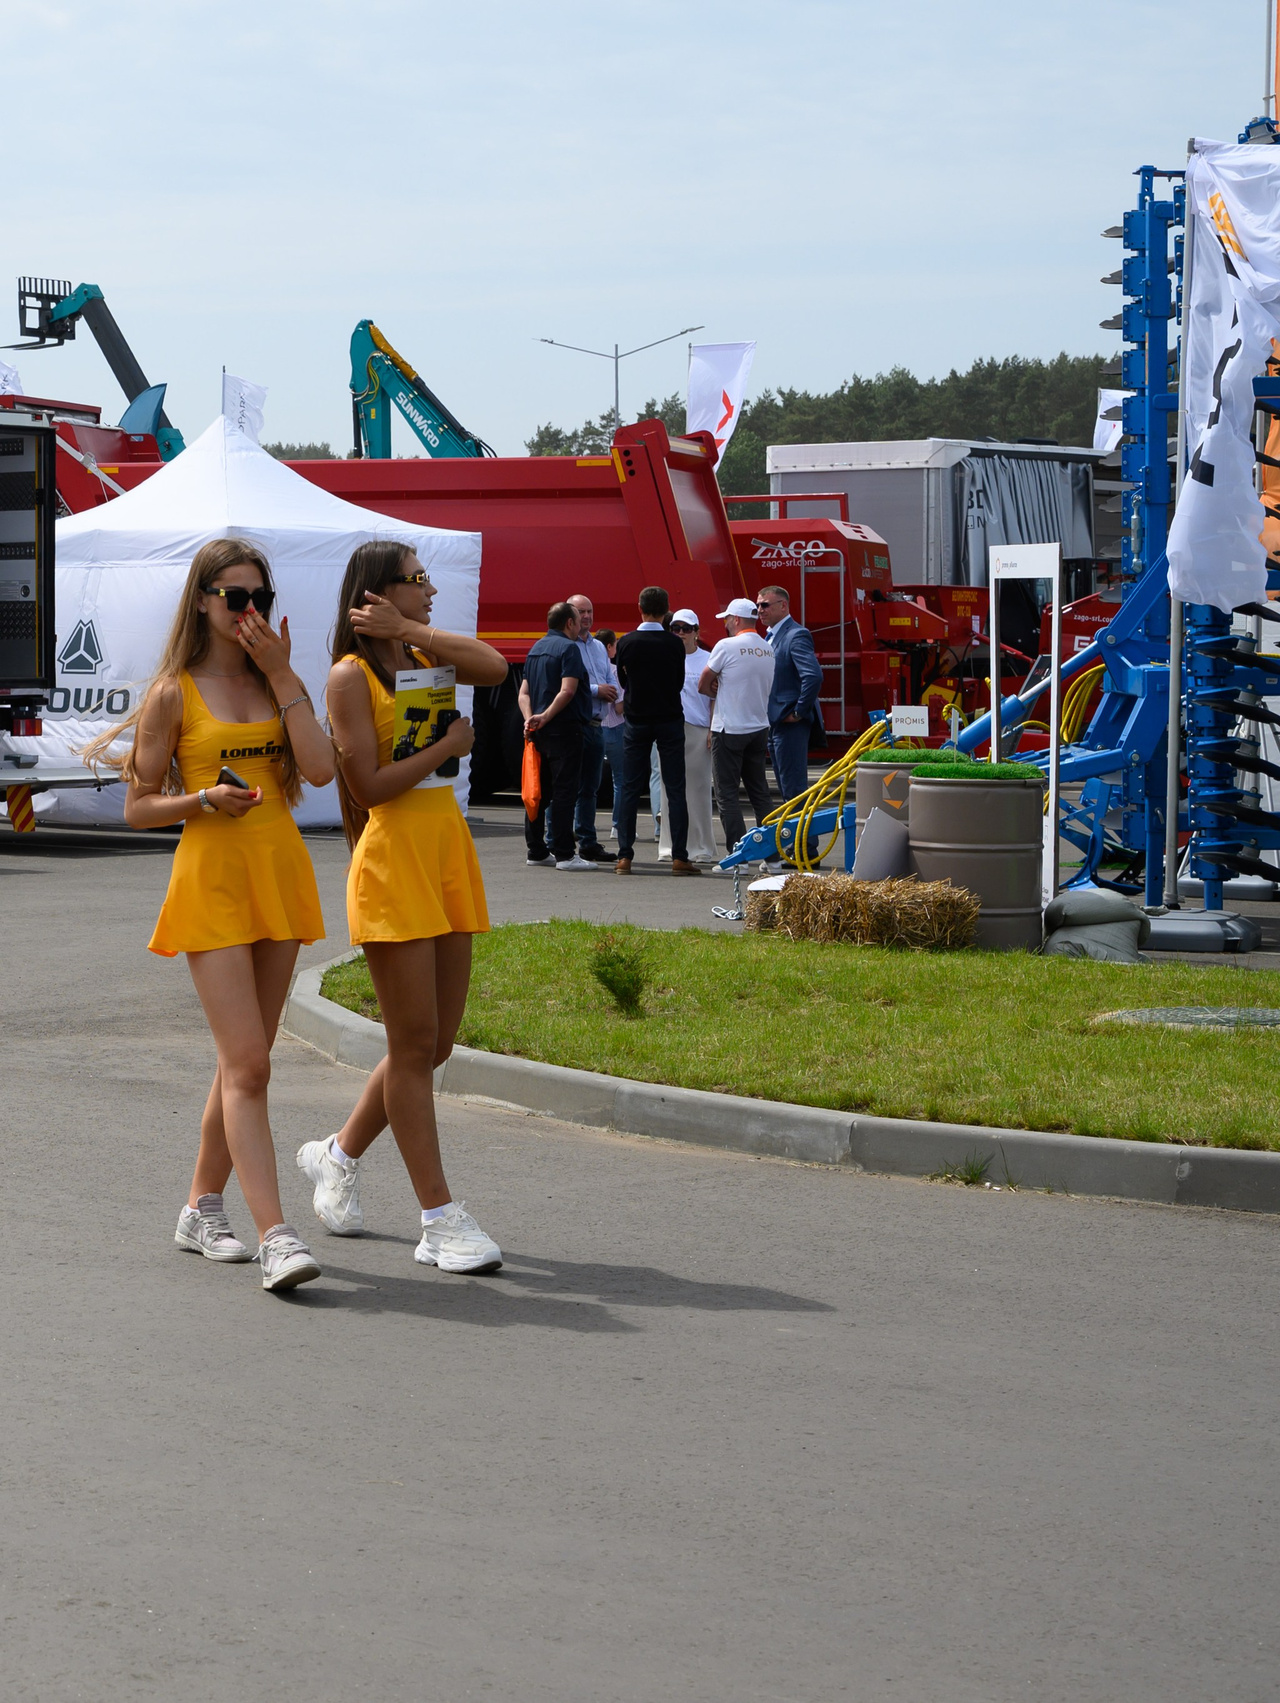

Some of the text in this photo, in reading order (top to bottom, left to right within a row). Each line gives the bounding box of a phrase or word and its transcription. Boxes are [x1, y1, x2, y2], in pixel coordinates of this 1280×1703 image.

[395, 391, 440, 448] SUNWARD
[751, 538, 826, 559] ZAGO
[36, 687, 130, 715] OWO
[895, 716, 925, 725] PROMIS
[220, 741, 282, 759] LONKIN
